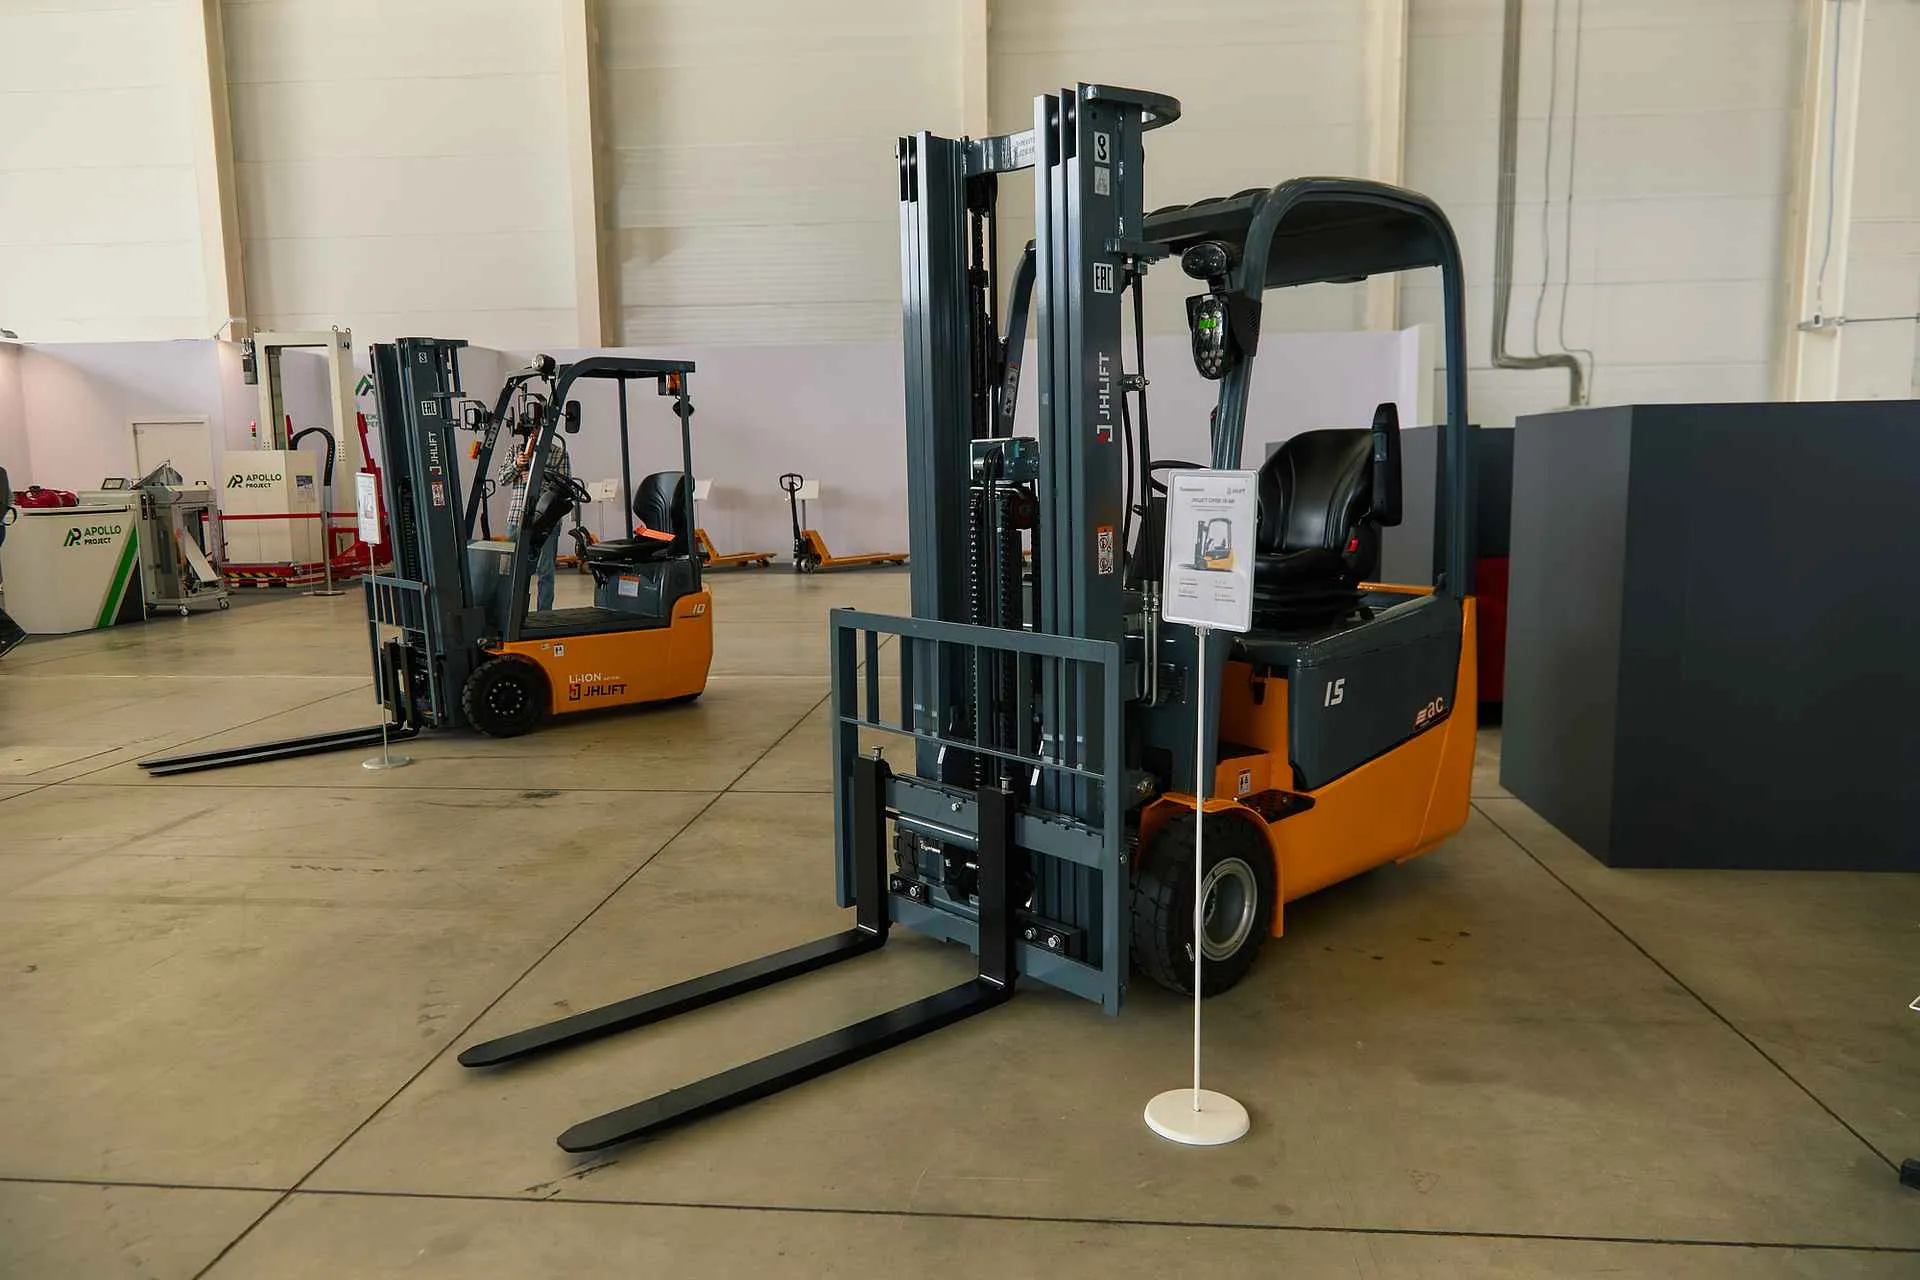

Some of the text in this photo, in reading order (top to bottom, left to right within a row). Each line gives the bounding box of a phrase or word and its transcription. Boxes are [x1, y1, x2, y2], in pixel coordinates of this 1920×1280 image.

[1096, 264, 1112, 291] EAC
[1099, 352, 1110, 420] JHLIFT
[428, 432, 438, 464] JHLIFT
[84, 525, 121, 536] APOLLO
[84, 537, 112, 545] PROJECT
[584, 684, 627, 696] JHLIFT
[1324, 678, 1345, 707] 15
